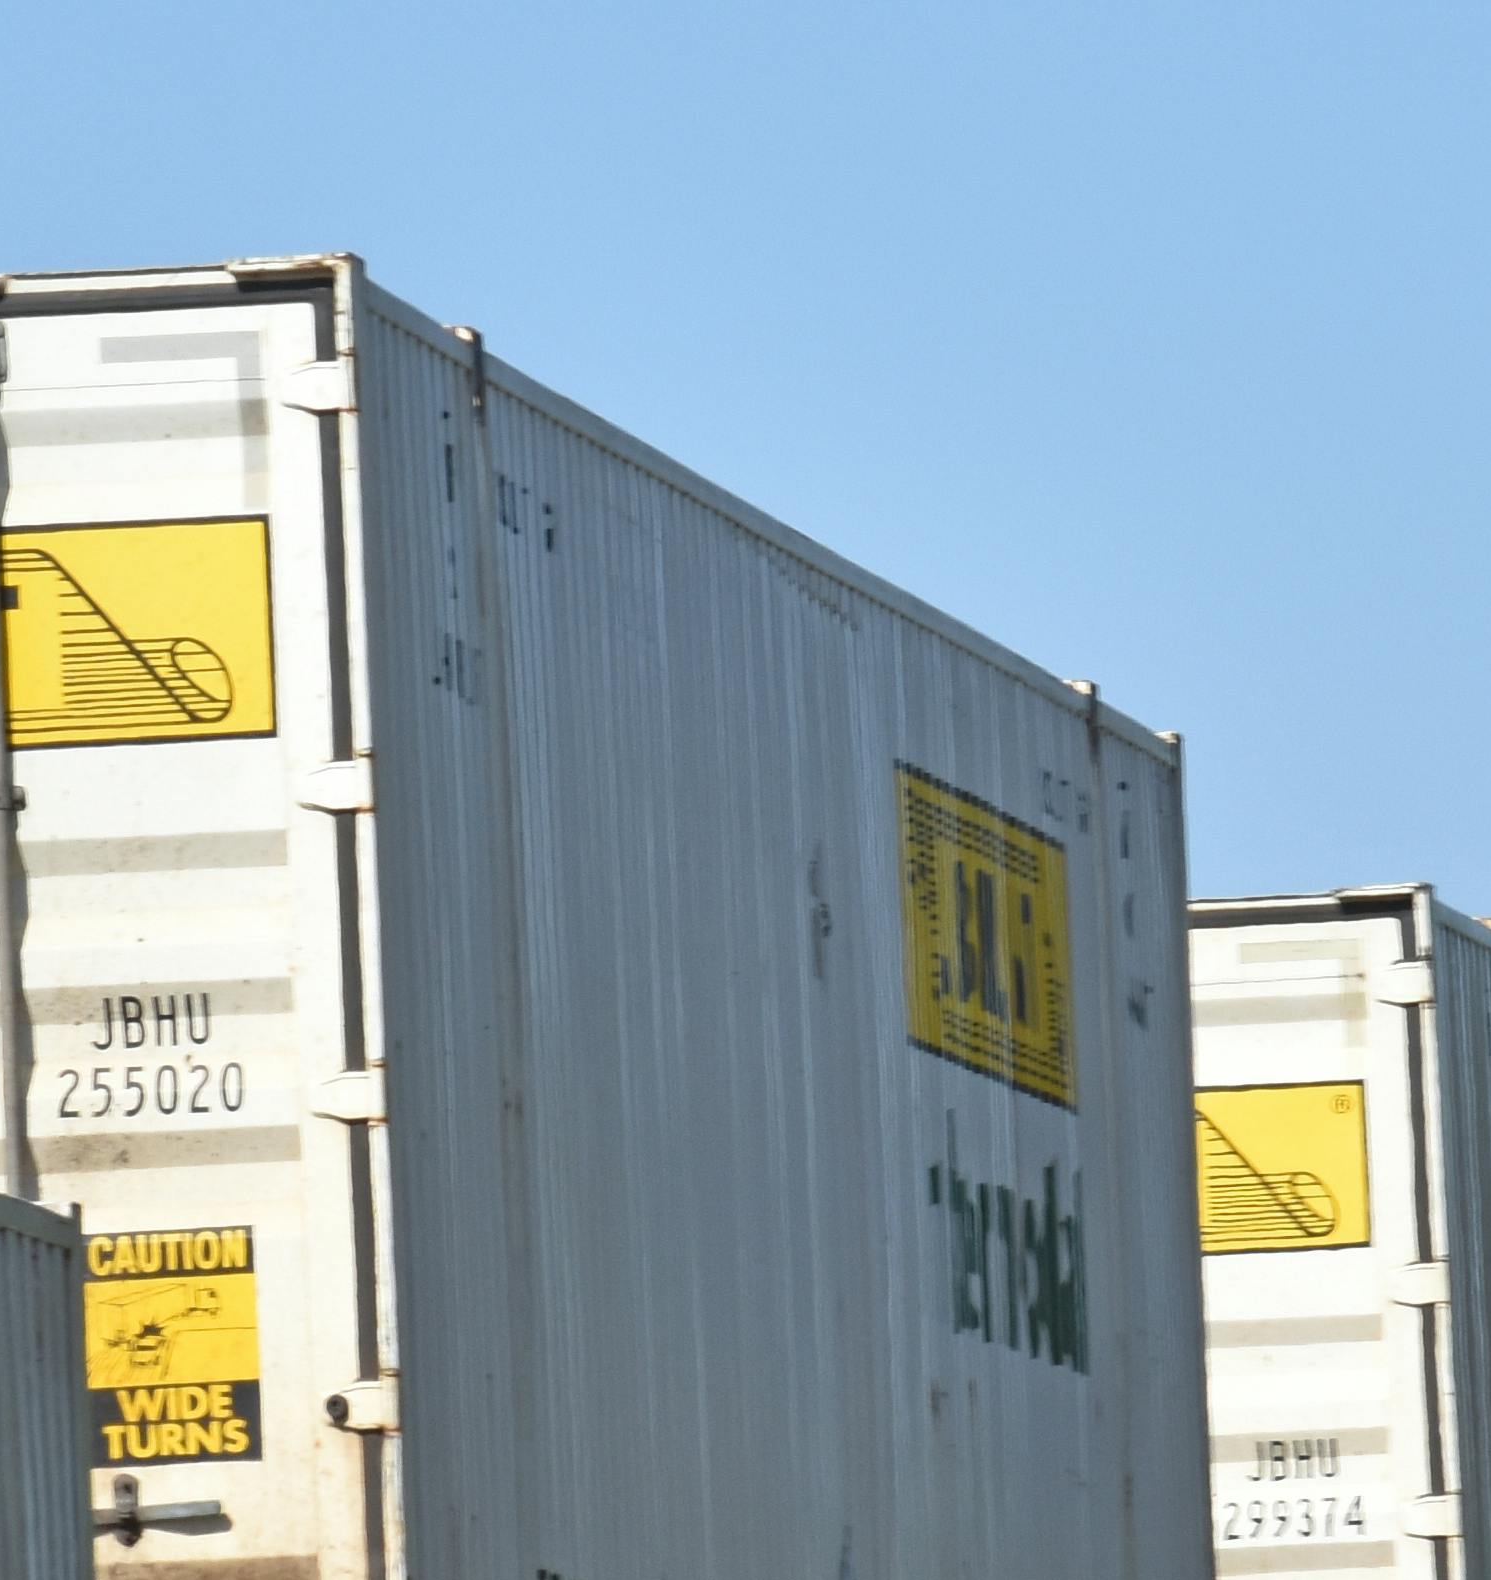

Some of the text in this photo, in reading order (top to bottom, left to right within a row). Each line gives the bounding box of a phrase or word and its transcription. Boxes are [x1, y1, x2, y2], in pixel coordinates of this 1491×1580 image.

[91, 993, 210, 1050] JBHU
[58, 1062, 244, 1118] 255020
[87, 1229, 249, 1276] CAUTION
[116, 1384, 234, 1433] WIDE
[102, 1419, 250, 1460] TURNS
[1246, 1438, 1341, 1481] JBHU
[1223, 1495, 1367, 1541] 299374
